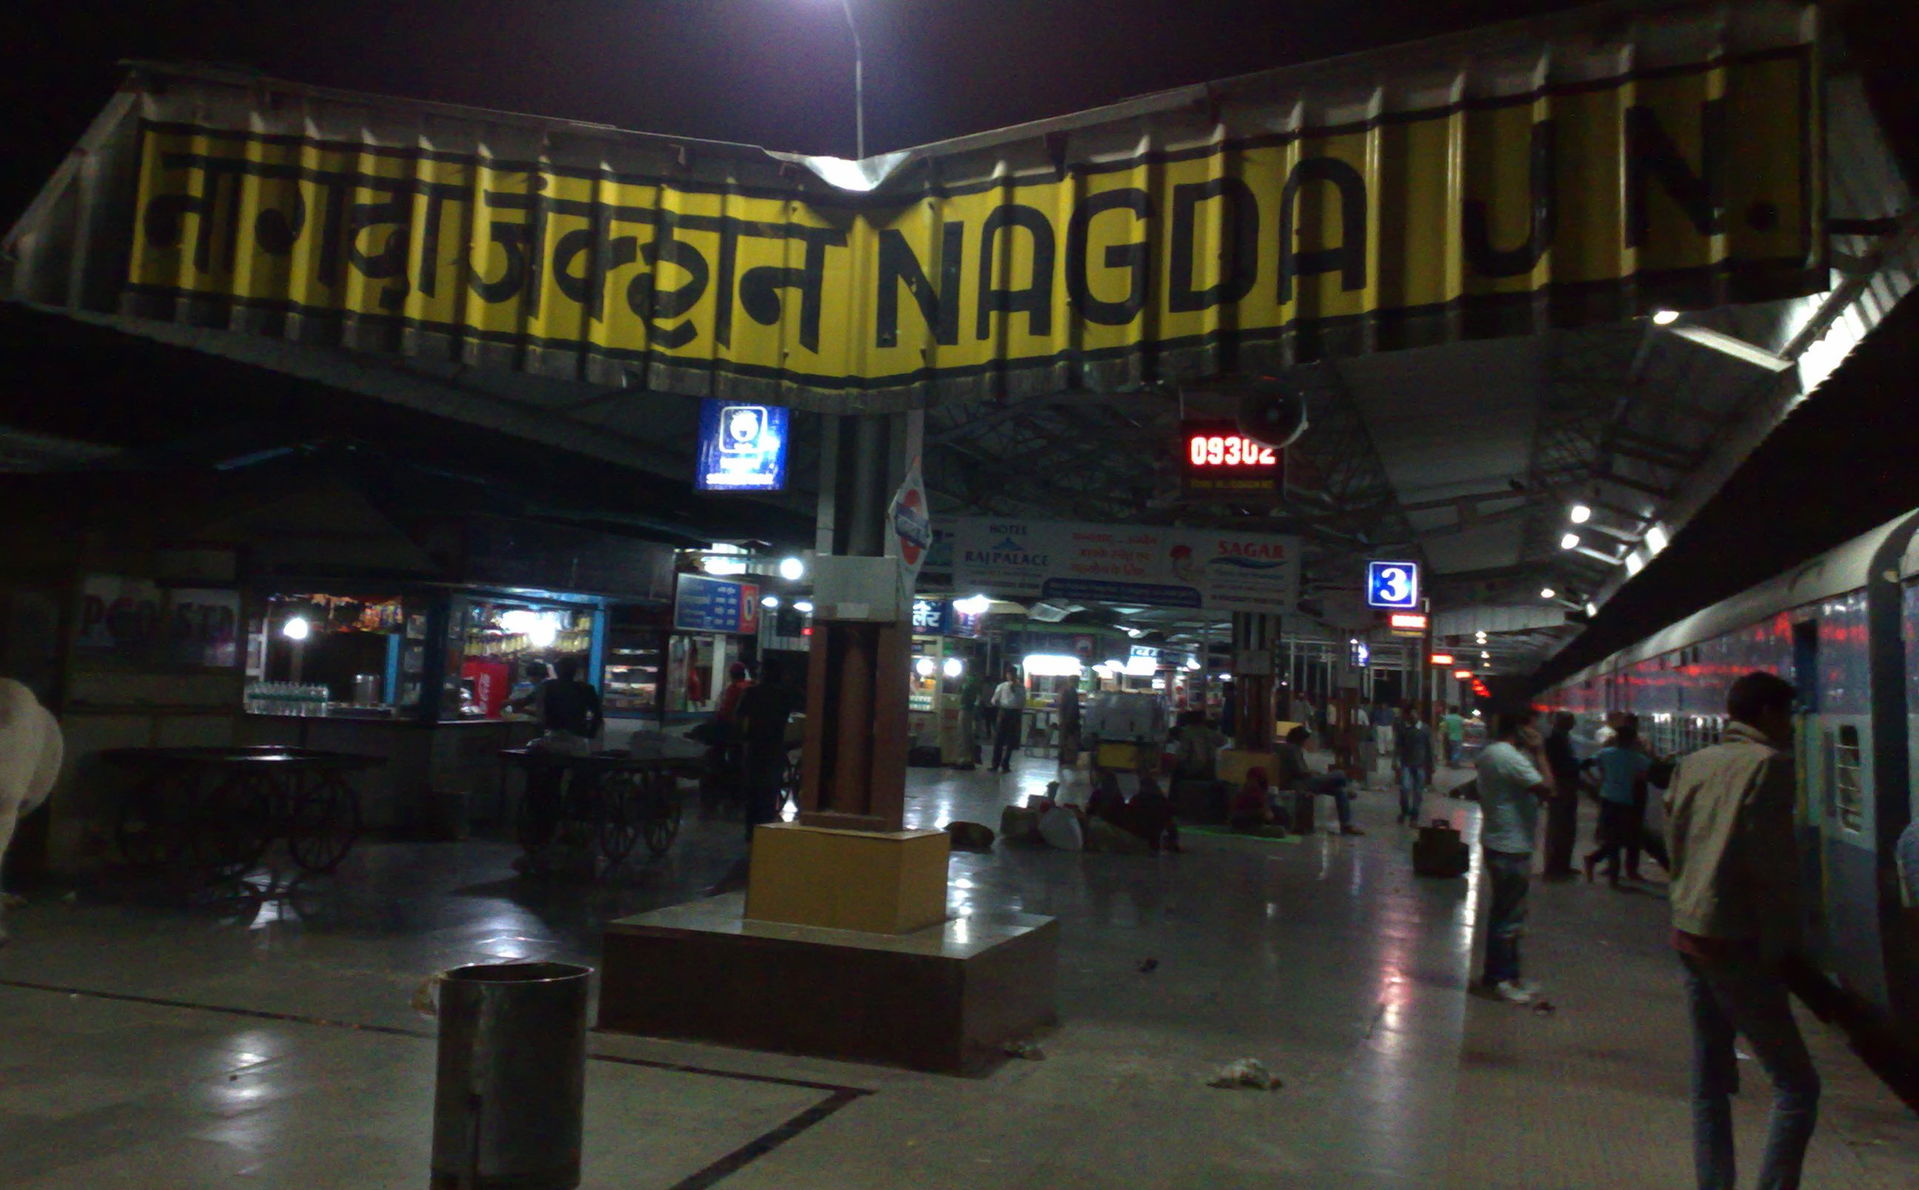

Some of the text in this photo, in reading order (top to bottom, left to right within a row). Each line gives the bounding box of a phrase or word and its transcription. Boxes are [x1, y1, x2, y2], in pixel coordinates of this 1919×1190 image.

[144, 152, 475, 309] नागदा
[876, 156, 1368, 348] NAGDA
[989, 524, 1028, 535] HOTEL
[992, 552, 1049, 567] PALACE
[1217, 539, 1285, 559] SAGAR
[1379, 567, 1411, 602] 3
